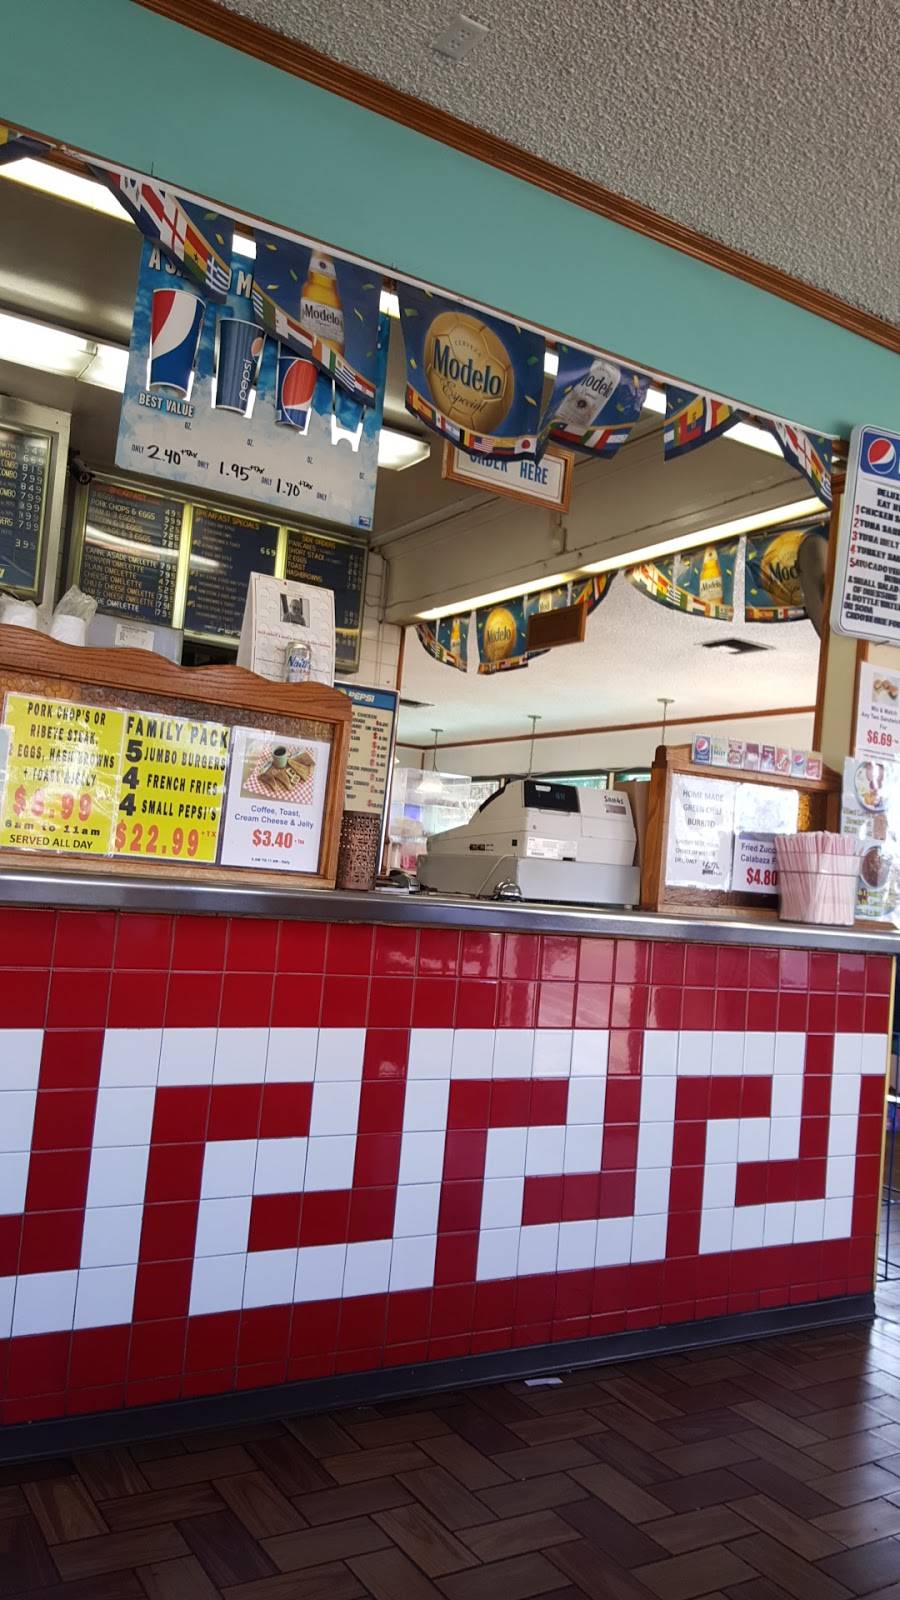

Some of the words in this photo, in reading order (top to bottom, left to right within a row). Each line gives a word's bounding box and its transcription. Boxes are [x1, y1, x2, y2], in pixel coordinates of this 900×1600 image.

[149, 248, 161, 270] A
[304, 304, 339, 325] Modelo
[433, 339, 502, 395] Modelo
[239, 359, 252, 401] pepsi
[139, 393, 162, 410] BEST
[166, 400, 194, 418] VALUE
[441, 380, 488, 413] Especial
[132, 444, 144, 453] ONLY
[147, 445, 181, 465] 2.40
[220, 461, 250, 481] 1.95
[520, 462, 548, 484] HERE
[276, 478, 300, 496] 1.70
[316, 492, 327, 501] ONLY
[856, 505, 859, 514] 1
[861, 506, 894, 521] CHICKEN
[877, 499, 890, 508] EAT
[854, 518, 860, 528] 2
[852, 532, 858, 541] 3
[486, 627, 512, 642] Modelo
[27, 702, 53, 718] PORK
[56, 705, 90, 723] CHOP'S
[94, 711, 106, 725] OR
[30, 724, 64, 741] RIBEYE
[126, 716, 183, 742] FAMILY
[191, 725, 228, 749] PACK
[867, 730, 892, 746] $6.69
[77, 750, 115, 769] BROWNS
[125, 739, 143, 763] 5
[144, 747, 177, 765] JUMBO
[181, 752, 226, 771] BURGERS
[122, 766, 140, 790] 4
[147, 773, 186, 792] FRENCH
[190, 780, 218, 796] FRIES
[683, 790, 702, 799] HOME
[119, 793, 137, 816] 4
[141, 799, 174, 816] SMALL
[178, 804, 216, 821] PEPSI'S
[251, 805, 277, 815] Coffee,
[280, 808, 300, 818] Toast,
[683, 804, 704, 813] GREEN
[42, 823, 56, 832] to
[64, 824, 100, 836] 11am
[234, 813, 258, 822] Cream
[261, 816, 288, 826] Cheese
[298, 820, 314, 830] Jelly
[9, 834, 50, 846] SERVED
[53, 839, 70, 848] ALL
[73, 840, 93, 849] DAY
[115, 819, 199, 857] $22.99
[252, 829, 293, 849] $3.40
[741, 843, 758, 852] Fried
[740, 855, 770, 864] Calabaza
[747, 867, 778, 886] $4.80
